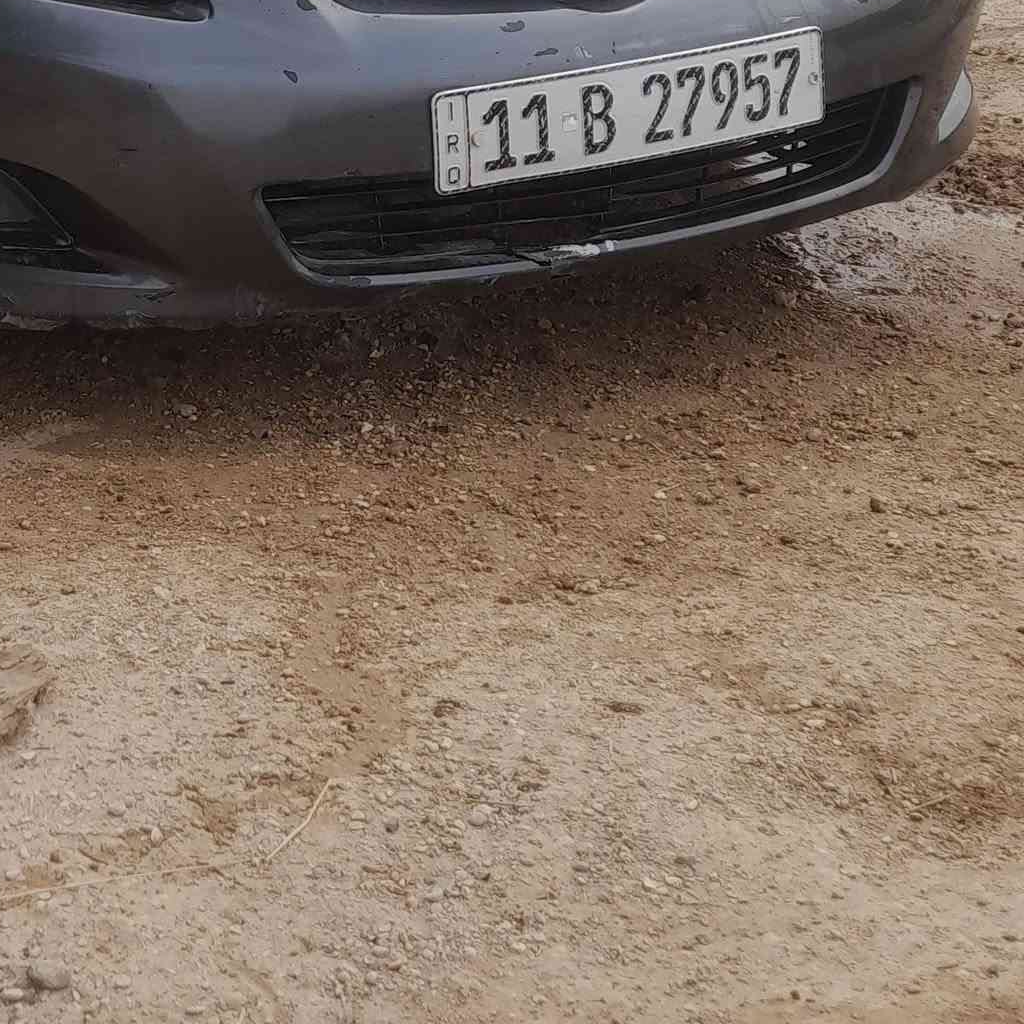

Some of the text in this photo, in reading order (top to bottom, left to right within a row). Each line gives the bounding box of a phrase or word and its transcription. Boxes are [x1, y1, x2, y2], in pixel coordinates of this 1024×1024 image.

[483, 47, 801, 172] 11 B 27957
